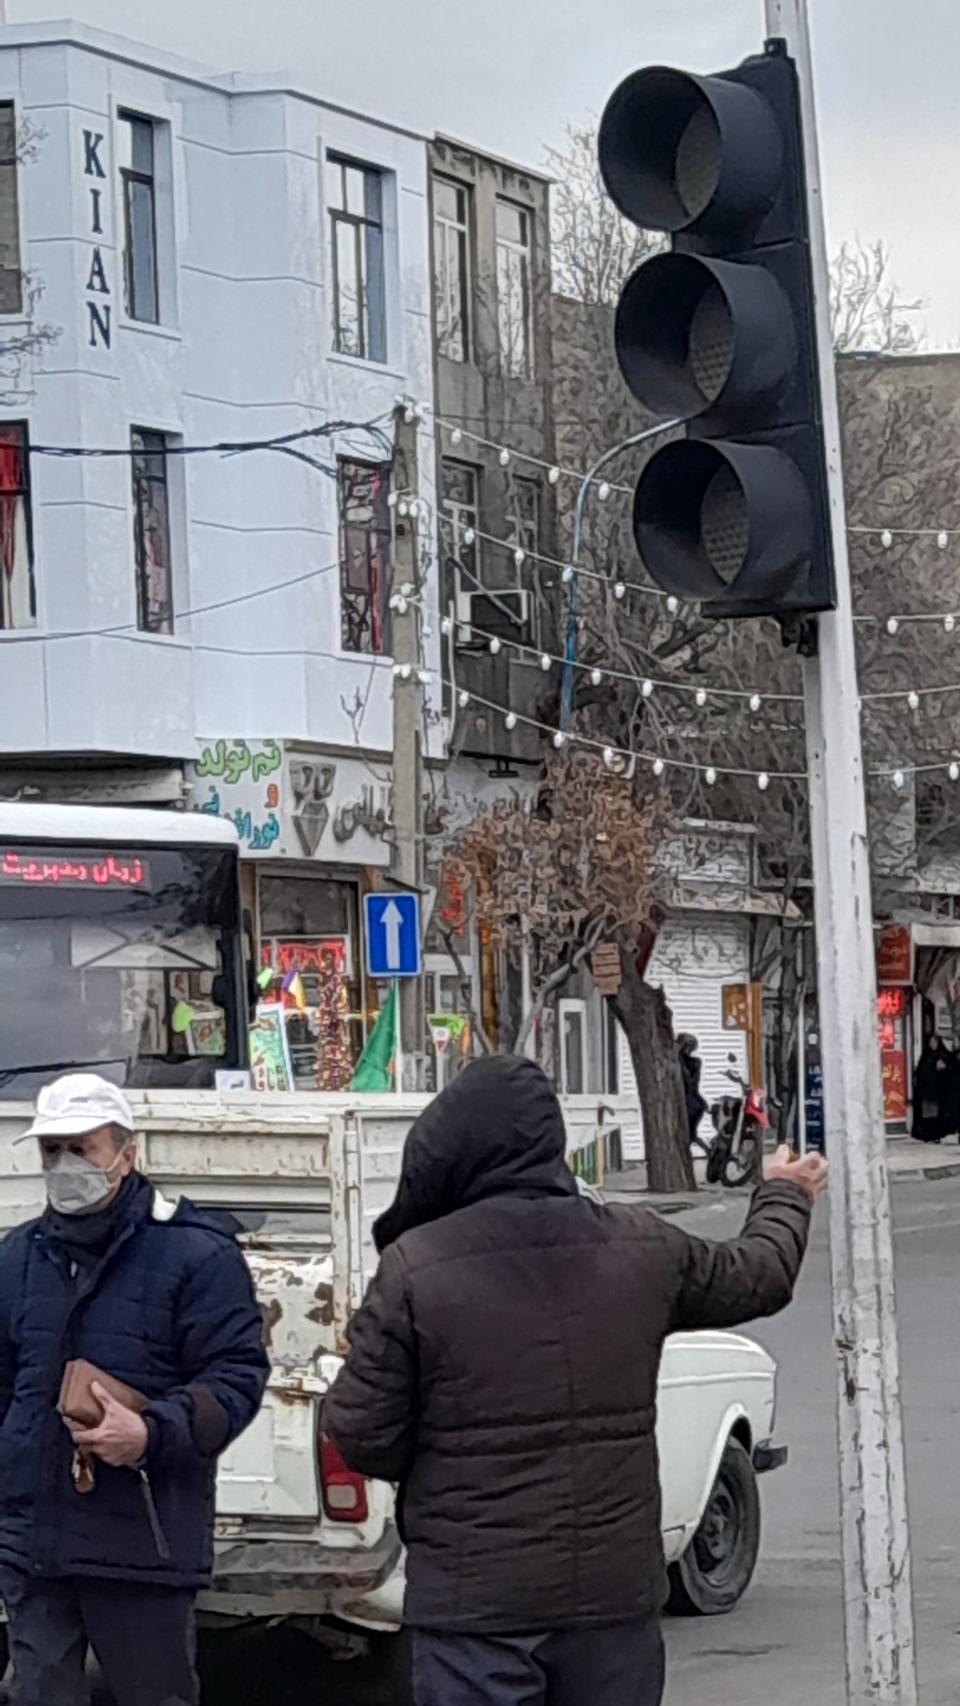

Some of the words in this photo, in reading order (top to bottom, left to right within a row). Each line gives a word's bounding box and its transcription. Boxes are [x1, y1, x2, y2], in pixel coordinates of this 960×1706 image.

[82, 128, 111, 351] KIAN
[195, 739, 251, 785] تولد
[252, 738, 282, 783] تم
